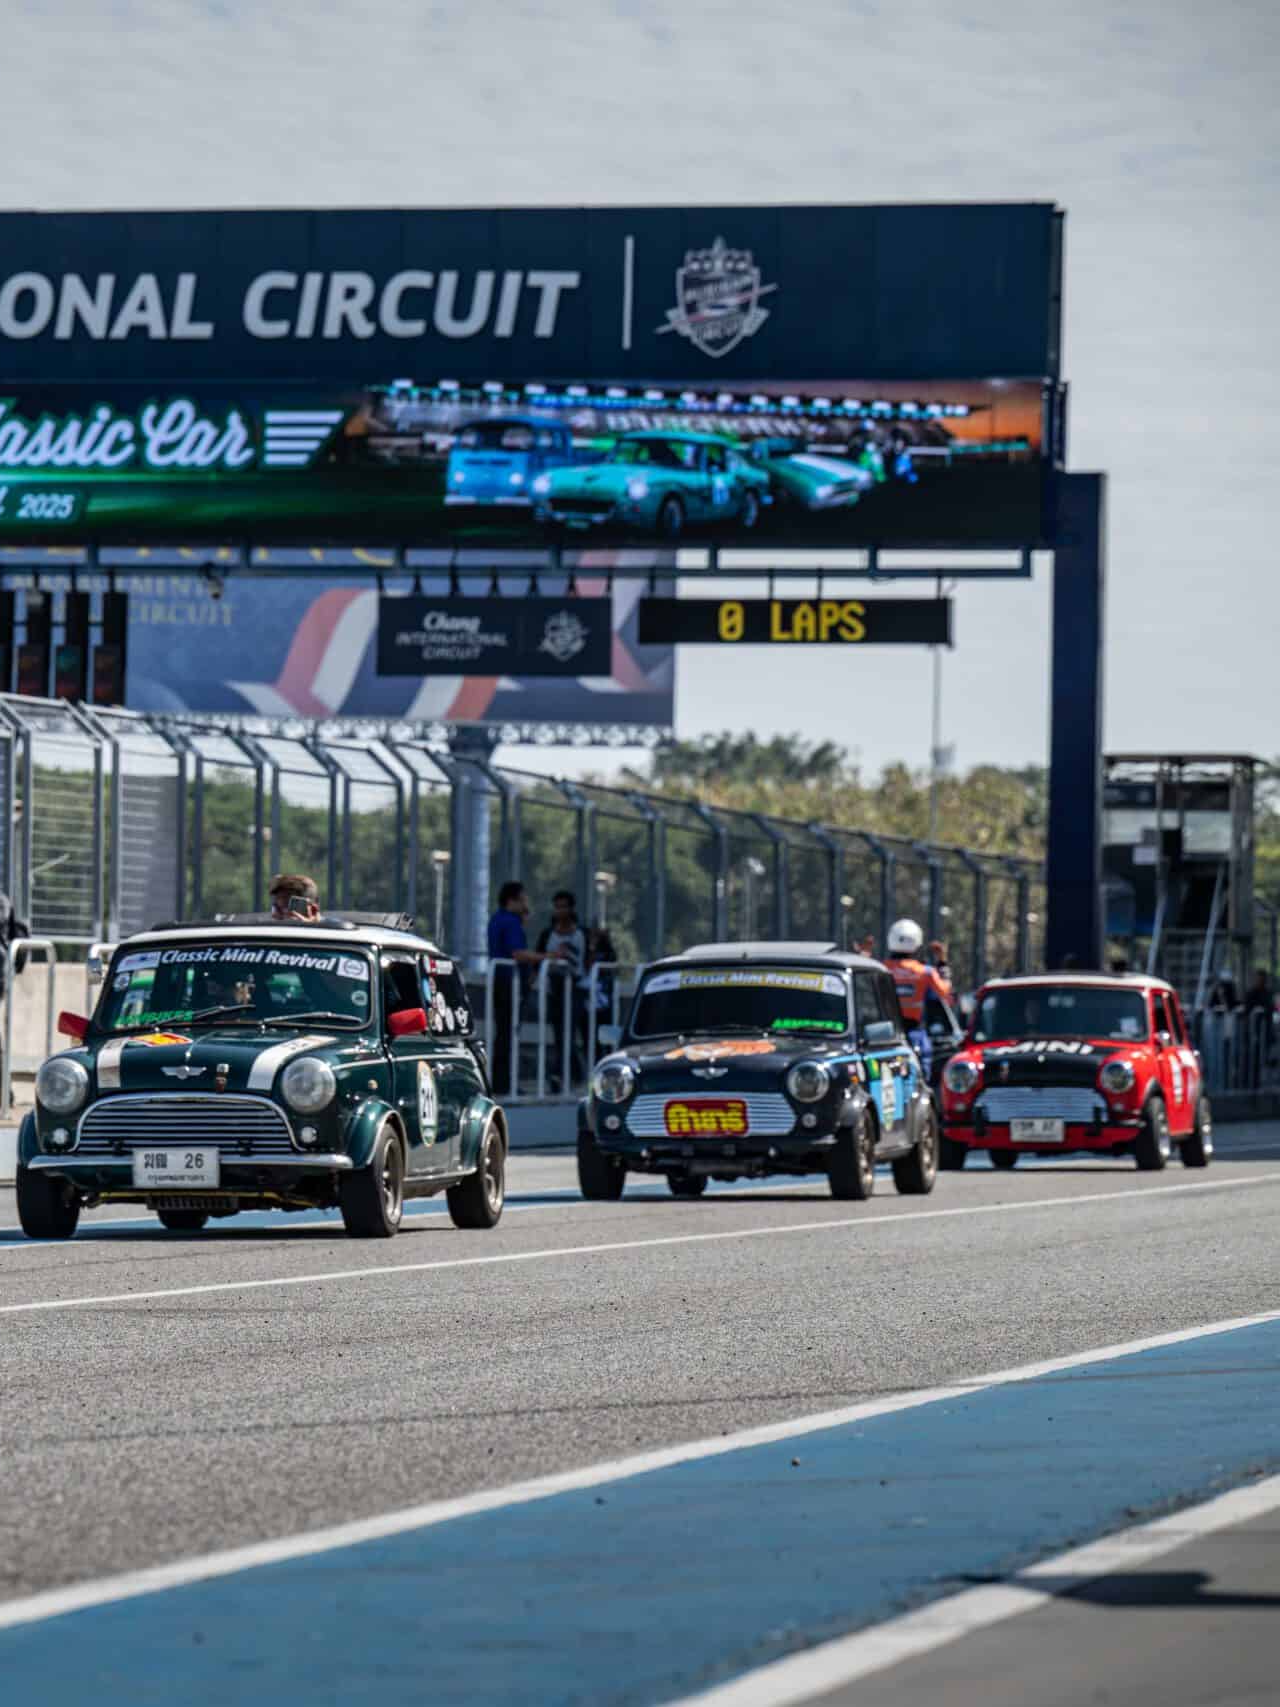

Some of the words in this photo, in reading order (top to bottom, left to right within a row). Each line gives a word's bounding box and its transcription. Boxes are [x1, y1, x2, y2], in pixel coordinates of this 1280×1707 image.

[243, 270, 580, 339] CIRCUIT
[141, 399, 254, 466] Car
[16, 493, 76, 519] 2025
[423, 611, 481, 632] Chang
[718, 600, 745, 642] 0
[770, 600, 867, 642] LAPS
[162, 948, 220, 964] Classic
[220, 947, 265, 963] Mini
[265, 951, 337, 972] Revival
[993, 1041, 1093, 1055] MINI
[184, 1152, 204, 1169] 26
